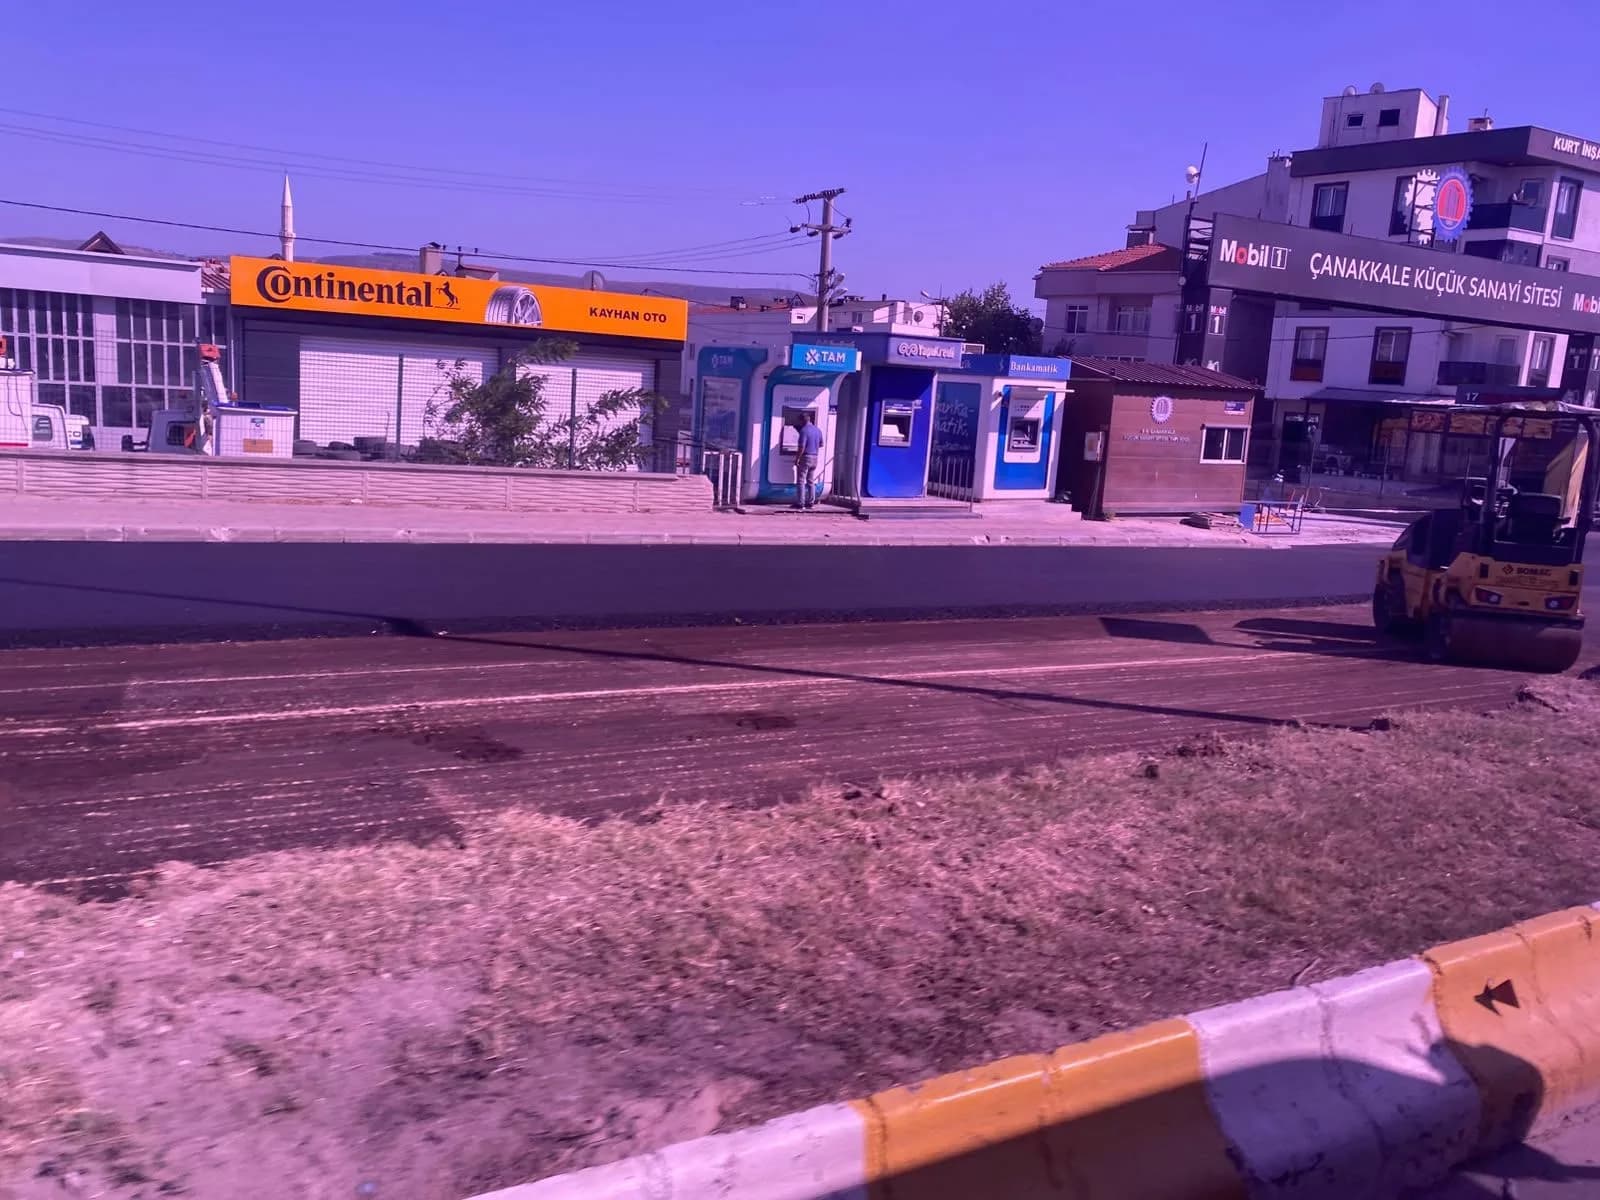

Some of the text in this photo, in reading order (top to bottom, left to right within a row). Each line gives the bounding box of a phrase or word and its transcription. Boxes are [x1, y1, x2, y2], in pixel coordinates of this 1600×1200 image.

[1553, 135, 1580, 154] KURT
[1220, 239, 1269, 268] Mobil
[256, 265, 434, 308] Continental
[1309, 252, 1563, 308] ÇANAKKALE KÜÇÜK SANAYİ SİTESİ
[589, 306, 667, 323] KAYHAN OTO
[821, 351, 846, 363] TAM
[1010, 361, 1058, 374] Bankamatik
